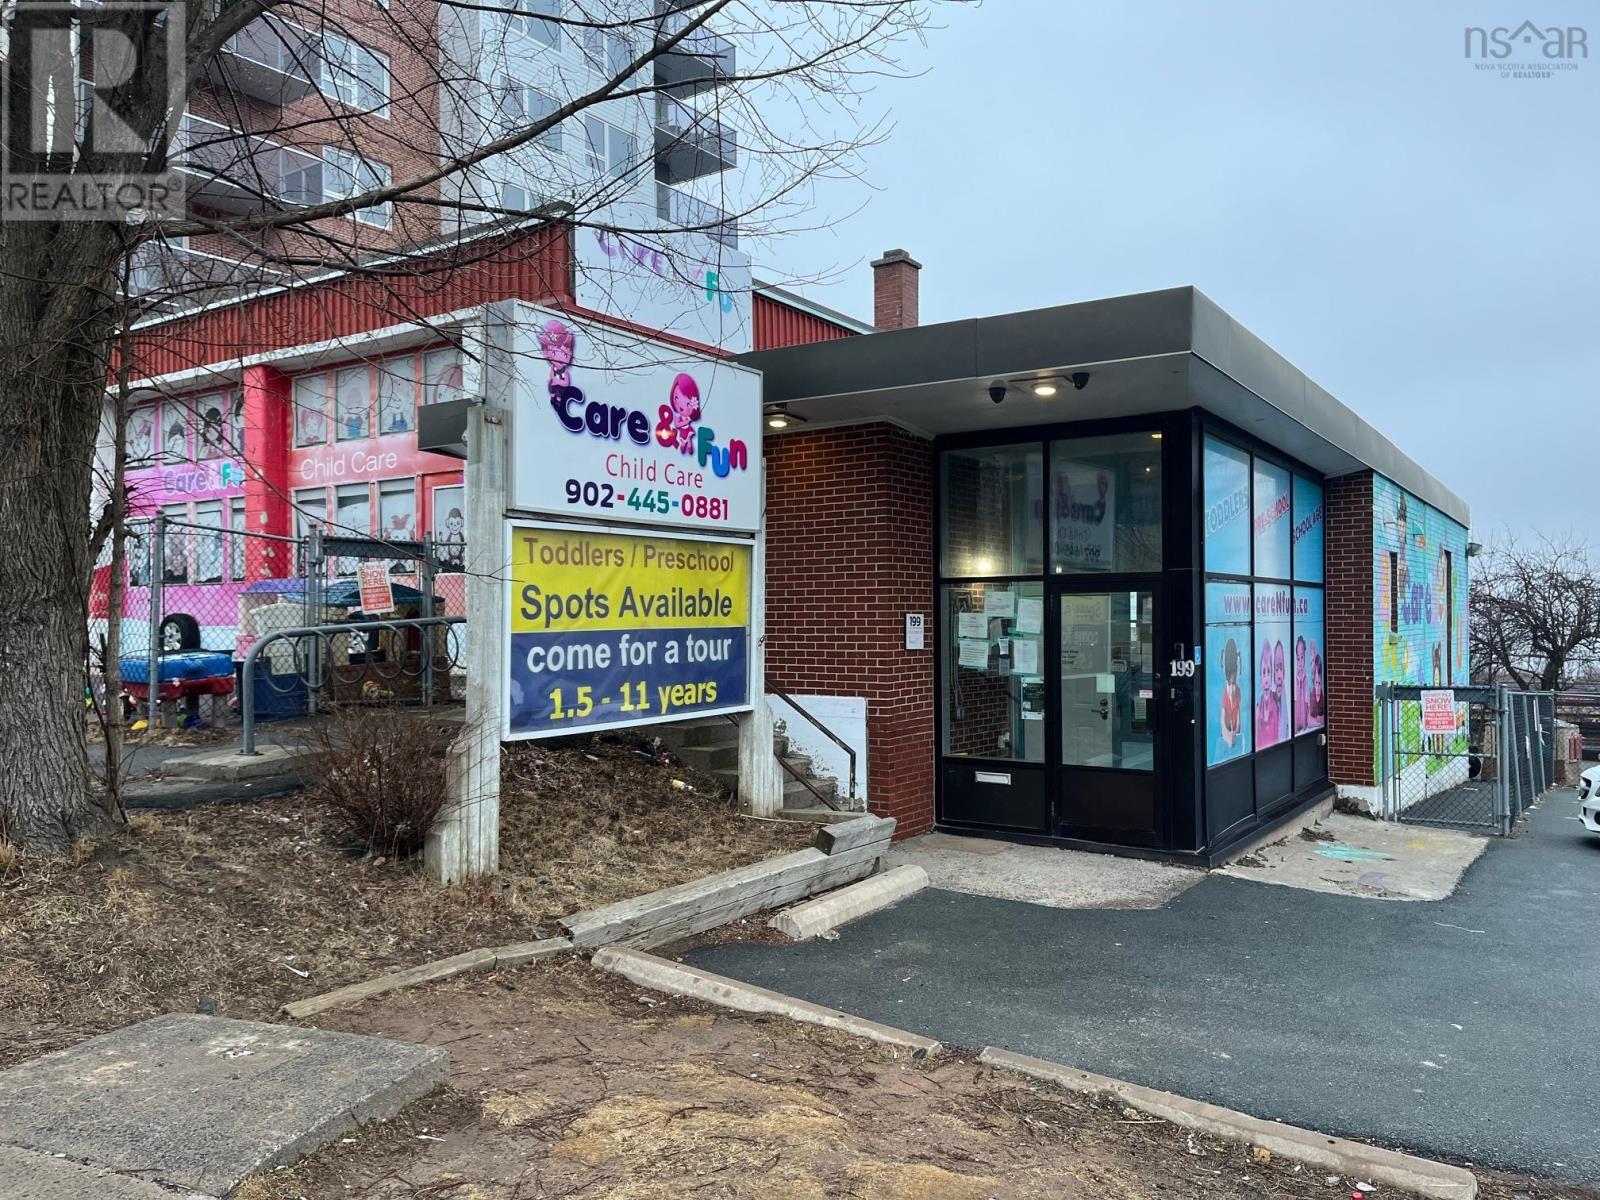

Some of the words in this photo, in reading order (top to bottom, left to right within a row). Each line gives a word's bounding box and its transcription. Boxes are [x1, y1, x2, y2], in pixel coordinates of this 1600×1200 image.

[552, 385, 651, 445] Care
[697, 426, 748, 479] Fun
[300, 453, 346, 480] Child
[351, 451, 398, 474] Care
[605, 453, 657, 483] Child
[664, 463, 704, 489] Care
[564, 478, 729, 521] 902-445-0881
[522, 537, 625, 568] Toddlers
[643, 544, 735, 573] Preschool
[360, 570, 386, 579] SNOW
[520, 584, 610, 628] Spots
[618, 585, 733, 618] Available
[909, 615, 922, 627] 199
[526, 640, 611, 673] come
[618, 633, 658, 667] for
[664, 638, 680, 664] a
[687, 632, 733, 663] tour
[1169, 659, 1195, 677] 199
[549, 685, 595, 720] 1.5
[618, 681, 651, 713] 11
[657, 680, 718, 715] years
